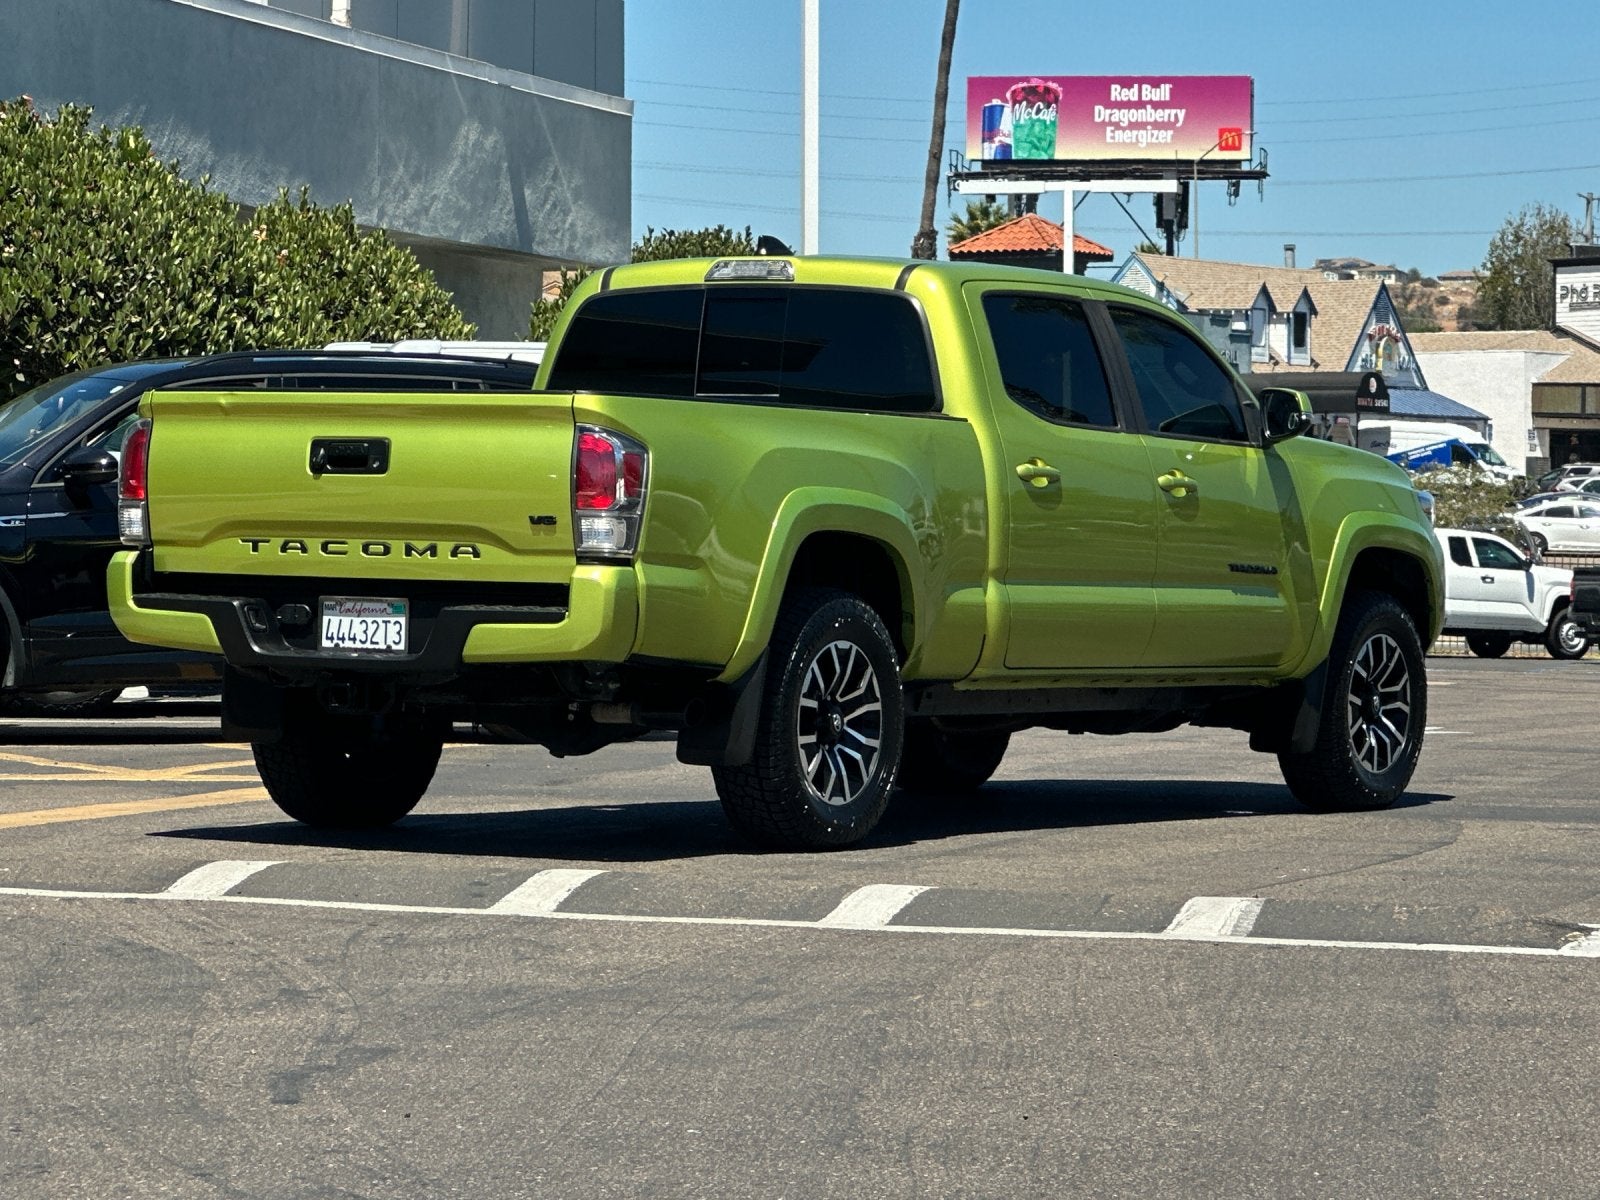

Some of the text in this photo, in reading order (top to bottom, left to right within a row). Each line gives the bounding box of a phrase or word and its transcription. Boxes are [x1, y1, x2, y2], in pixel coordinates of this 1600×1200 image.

[1110, 83, 1171, 101] Red Bull
[1013, 100, 1057, 125] McCafé
[1094, 104, 1187, 127] Dragonberry
[1105, 125, 1174, 148] Energizer
[238, 537, 481, 560] TACOMA
[337, 601, 392, 617] California
[325, 618, 402, 645] 44432T3
